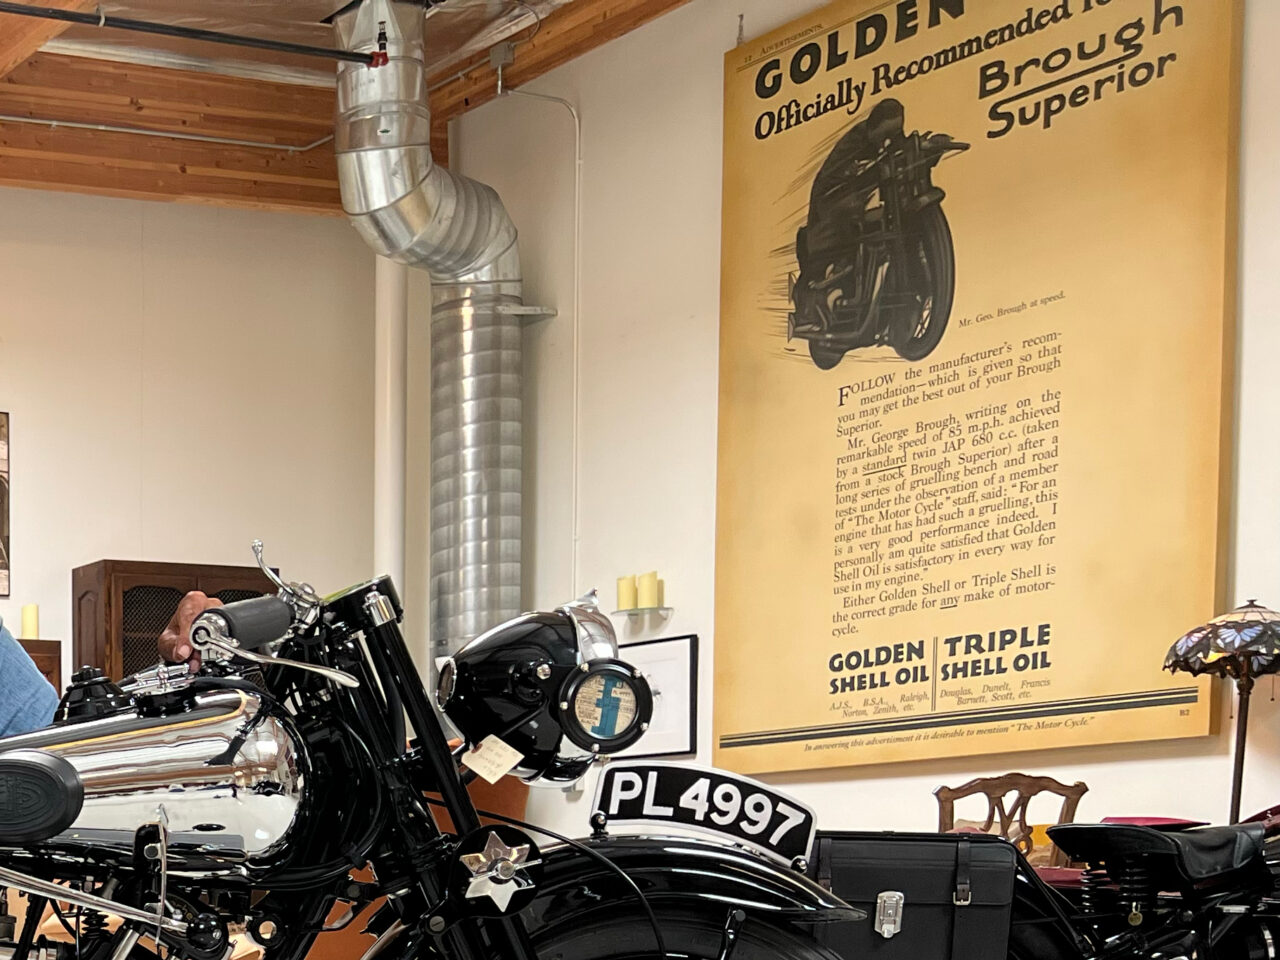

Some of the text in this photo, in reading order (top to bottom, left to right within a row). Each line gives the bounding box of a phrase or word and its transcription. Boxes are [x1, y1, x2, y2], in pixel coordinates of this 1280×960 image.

[754, 0, 1072, 140] Officially Recommended
[755, 0, 965, 99] GOLDEN
[979, 0, 1183, 99] Brough
[987, 53, 1176, 138] Superior
[958, 318, 973, 328] Mr.
[975, 313, 994, 323] Geo.
[996, 301, 1027, 317] Brough
[1029, 299, 1038, 308] at
[837, 332, 1061, 407] FOLLOW the manufacturer's recom-
[982, 358, 1013, 376] given
[1019, 353, 1032, 363] so
[1037, 344, 1062, 359] that
[837, 356, 1060, 426] you may get the best out of your Brough
[836, 419, 882, 437] Superior.
[836, 400, 1060, 465] remarkable speed of 85 m.p.h. achieved
[847, 389, 1061, 450] Mr. George Brough, writing on the
[835, 437, 1046, 493] from stock Brough Superior) after
[836, 467, 848, 480] by
[862, 450, 907, 472] standard
[912, 446, 936, 461] twin
[942, 437, 965, 454] JAP
[998, 430, 1017, 440] c.c.
[1022, 419, 1059, 437] (taken
[835, 445, 1058, 505] long series of gruelling bench and road
[835, 462, 1058, 518] tests under the observation of member
[834, 517, 846, 530] of
[878, 508, 911, 522] Motor
[952, 490, 978, 510] staff,
[980, 485, 1007, 501] said:
[1041, 478, 1056, 488] an
[834, 489, 1058, 543] engine that has had such gruelling, this
[858, 506, 1039, 551] very good performance indeed.
[833, 533, 1056, 582] Shell Oil satisfactory every way for
[834, 519, 1056, 573] personally am quite satisfied that Golden
[832, 581, 1055, 623] the correct grade for any make of motor-
[833, 585, 849, 595] use
[865, 579, 881, 590] my
[843, 564, 1041, 608] Either Golden Shell or Triple Shell
[832, 622, 858, 638] cycle.
[944, 624, 1051, 657] TRIPLE
[829, 640, 925, 672] GOLDEN
[829, 665, 929, 694] SHELL OIL
[941, 651, 1051, 681] SHELL OIL
[1021, 679, 1050, 689] Francis
[967, 729, 974, 737] to
[976, 725, 1008, 735] mention
[1034, 721, 1062, 730] Motor
